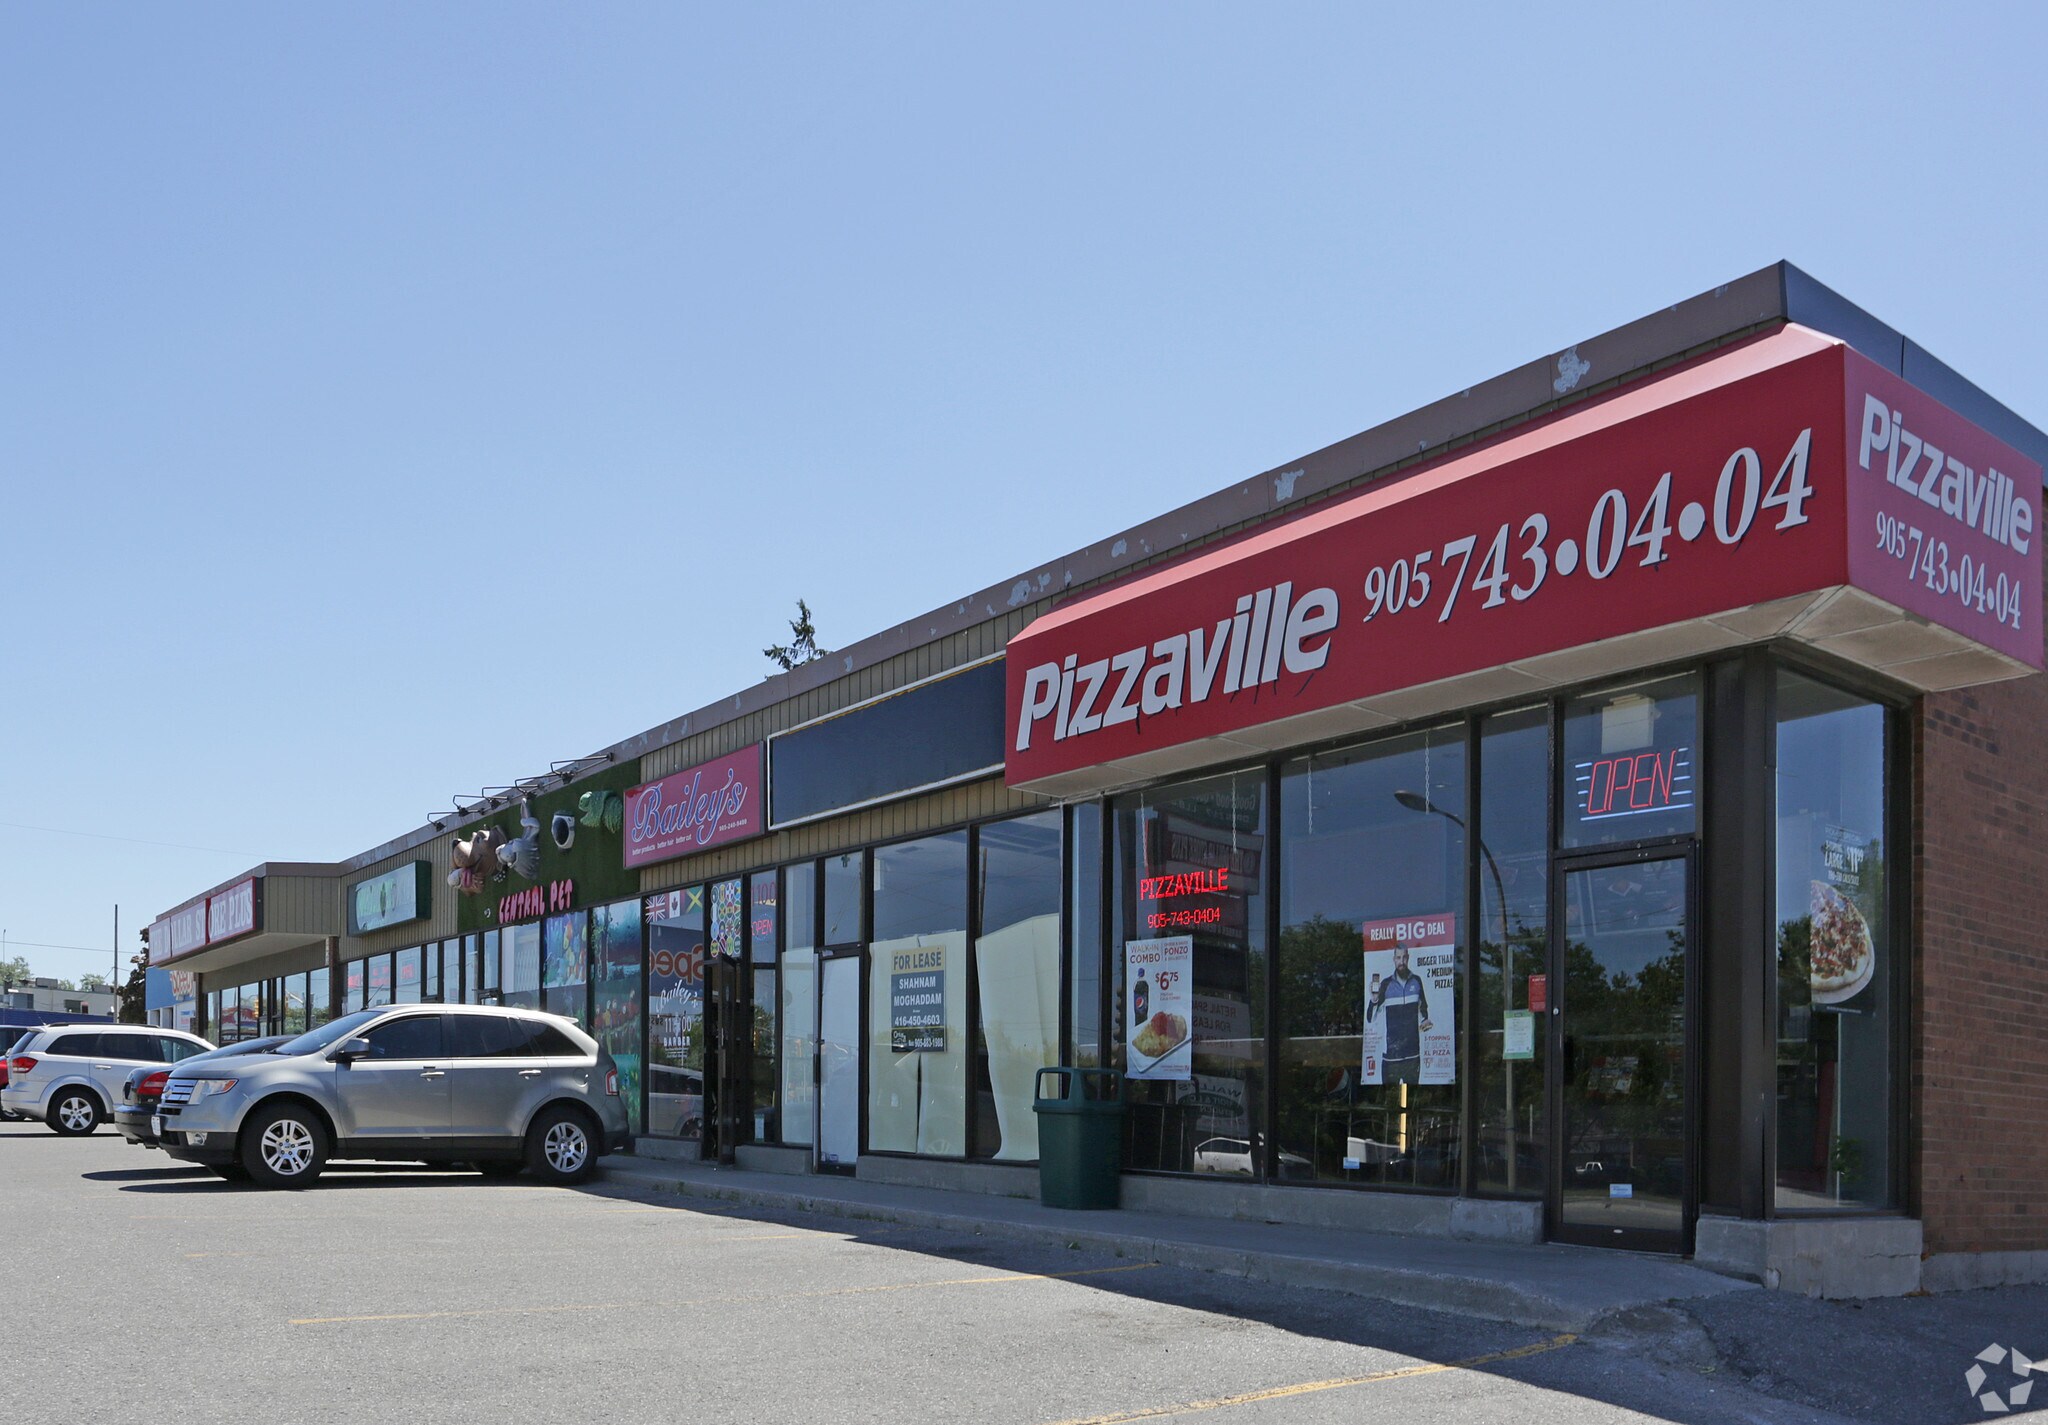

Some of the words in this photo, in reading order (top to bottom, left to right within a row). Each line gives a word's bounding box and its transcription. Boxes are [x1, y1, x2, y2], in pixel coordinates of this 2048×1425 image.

[1859, 393, 2033, 555] Pizzaville
[1876, 511, 1906, 559] 905
[1016, 580, 1340, 751] Pizzaville
[1363, 550, 1432, 623] 905
[1588, 750, 1677, 814] OPEN
[631, 768, 748, 845] Bailey's
[1140, 867, 1229, 900] PIZZAVILLE
[228, 887, 253, 931] PLUS
[499, 885, 545, 924] CENTRAL
[550, 879, 573, 912] PET
[1147, 907, 1221, 929] 905-743-0404
[1370, 927, 1395, 941] REALLY
[1396, 921, 1426, 941] BIG
[1427, 921, 1446, 936] DEAL
[1130, 953, 1161, 964] COMBO
[1164, 945, 1189, 956] PONZO
[1417, 955, 1437, 967] BIGGER
[1438, 954, 1453, 965] THAN
[893, 954, 911, 971] FOR
[913, 951, 942, 969] LEASE
[1427, 969, 1431, 978] 2
[1431, 967, 1453, 978] MEDIUM
[899, 976, 936, 990] SHAHNAM
[1434, 979, 1453, 989] PIZZAS
[655, 979, 699, 1018] Bailey's
[893, 993, 942, 1007] MOGHADDAM
[894, 1014, 940, 1027] 416-450-4603
[663, 1036, 691, 1047] BARBER
